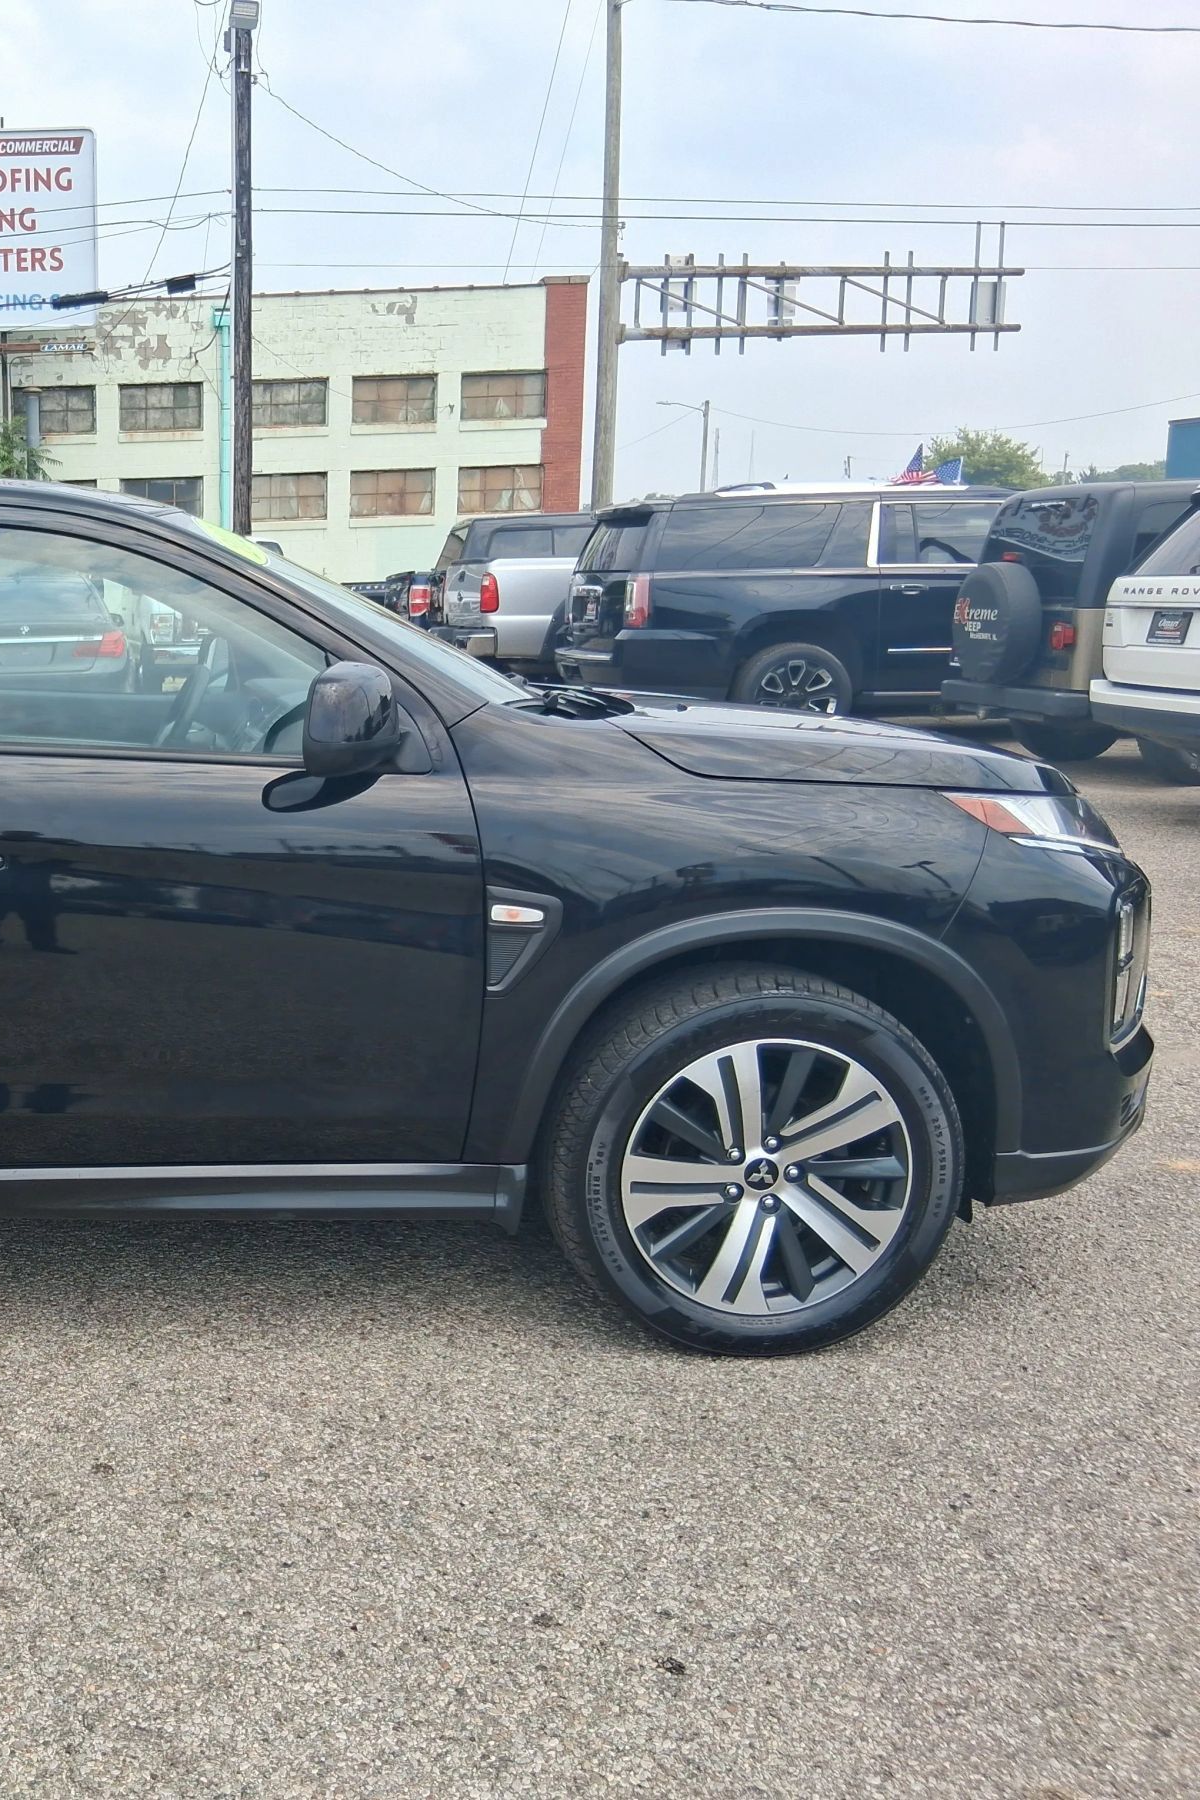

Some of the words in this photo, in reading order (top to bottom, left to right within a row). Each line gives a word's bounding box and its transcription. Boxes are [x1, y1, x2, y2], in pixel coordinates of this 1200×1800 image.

[0, 140, 76, 153] COMMERCIAL
[43, 342, 85, 352] LAMAR
[964, 621, 981, 631] JEEP
